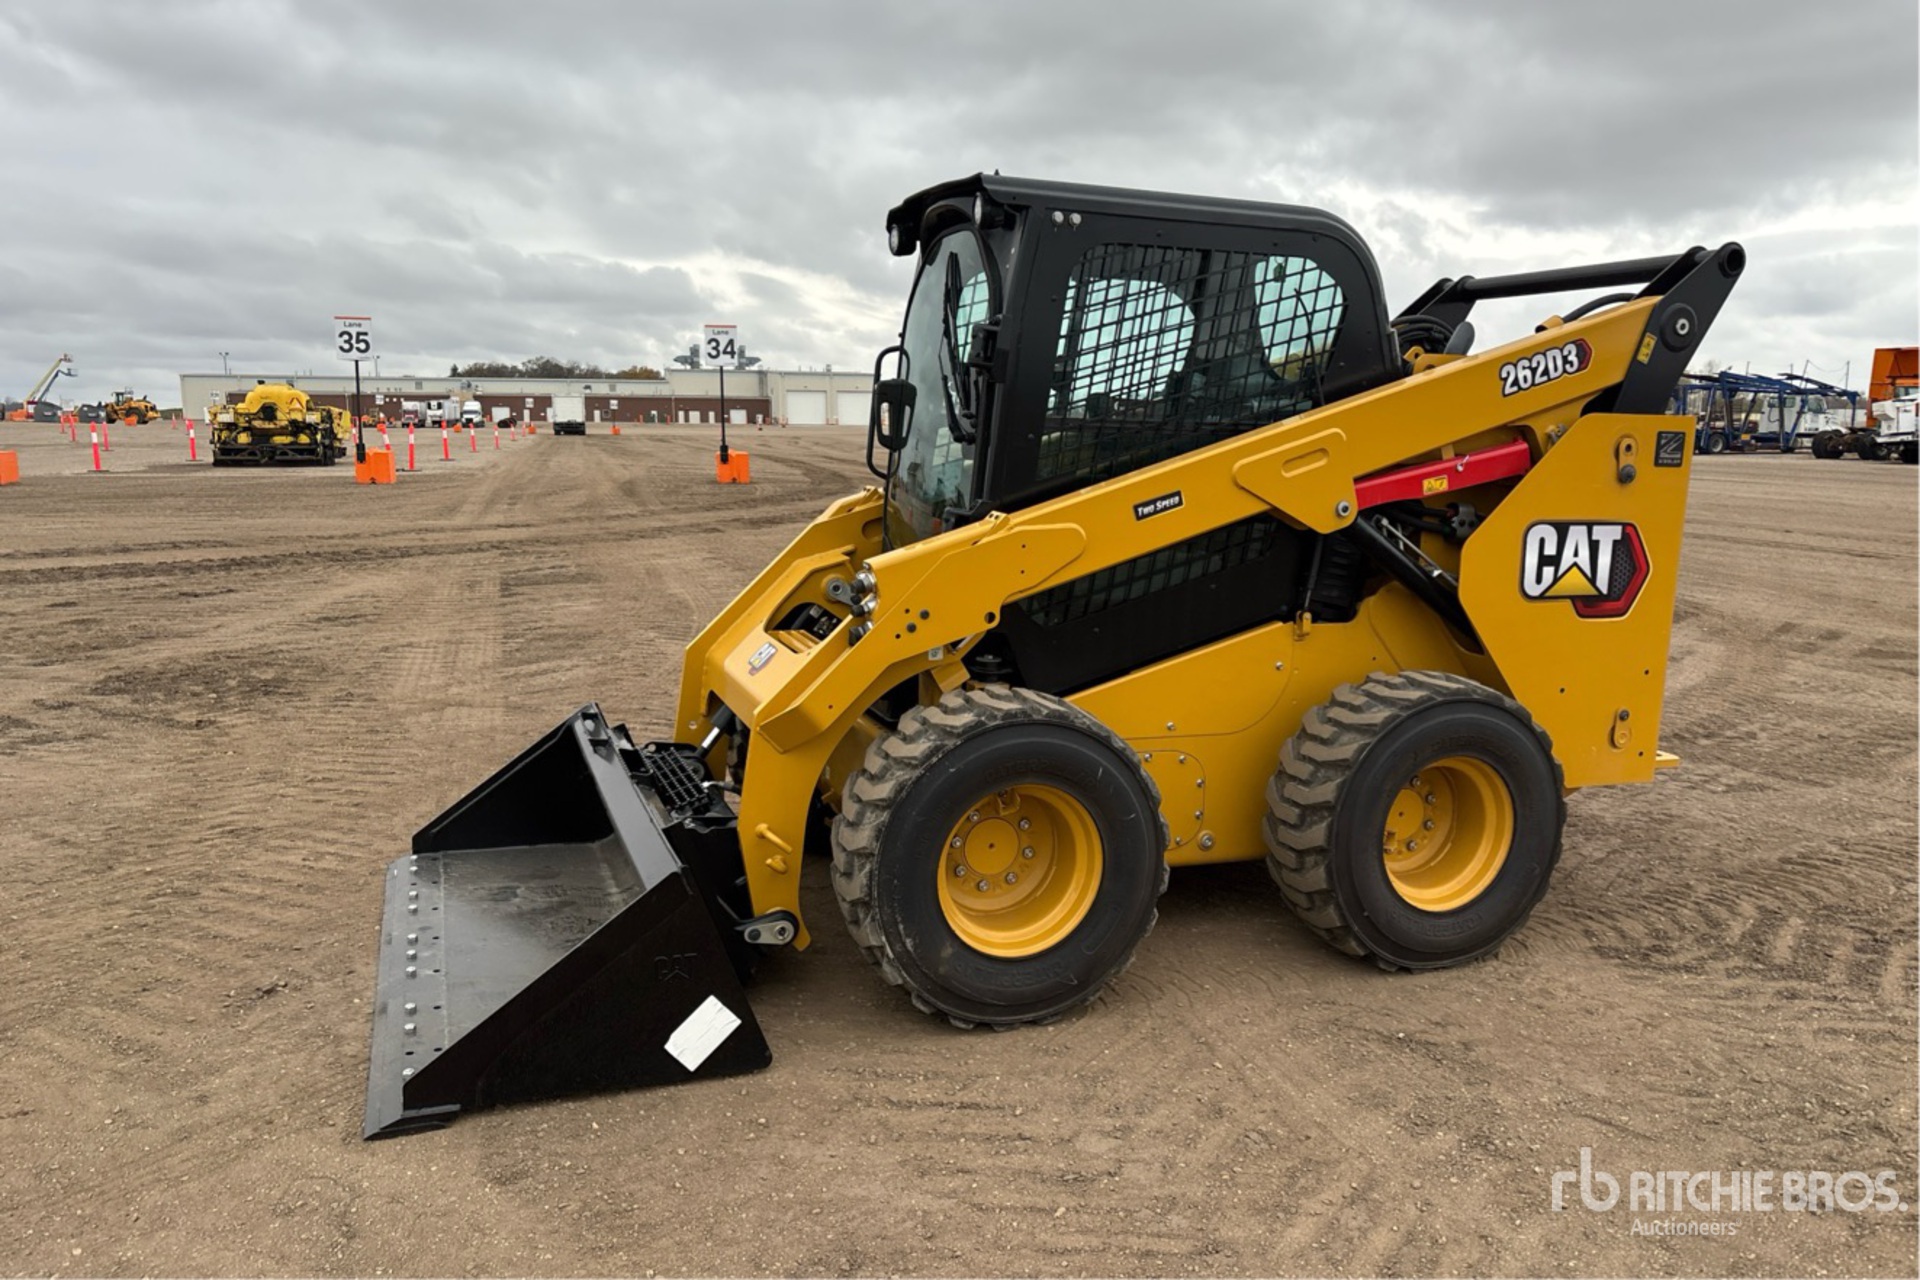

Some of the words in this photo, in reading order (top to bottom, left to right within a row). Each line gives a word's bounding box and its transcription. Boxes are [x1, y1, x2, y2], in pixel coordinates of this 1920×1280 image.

[338, 330, 371, 354] 35
[707, 337, 737, 360] 34
[1501, 342, 1580, 396] 262D3
[1523, 523, 1623, 597] CAT
